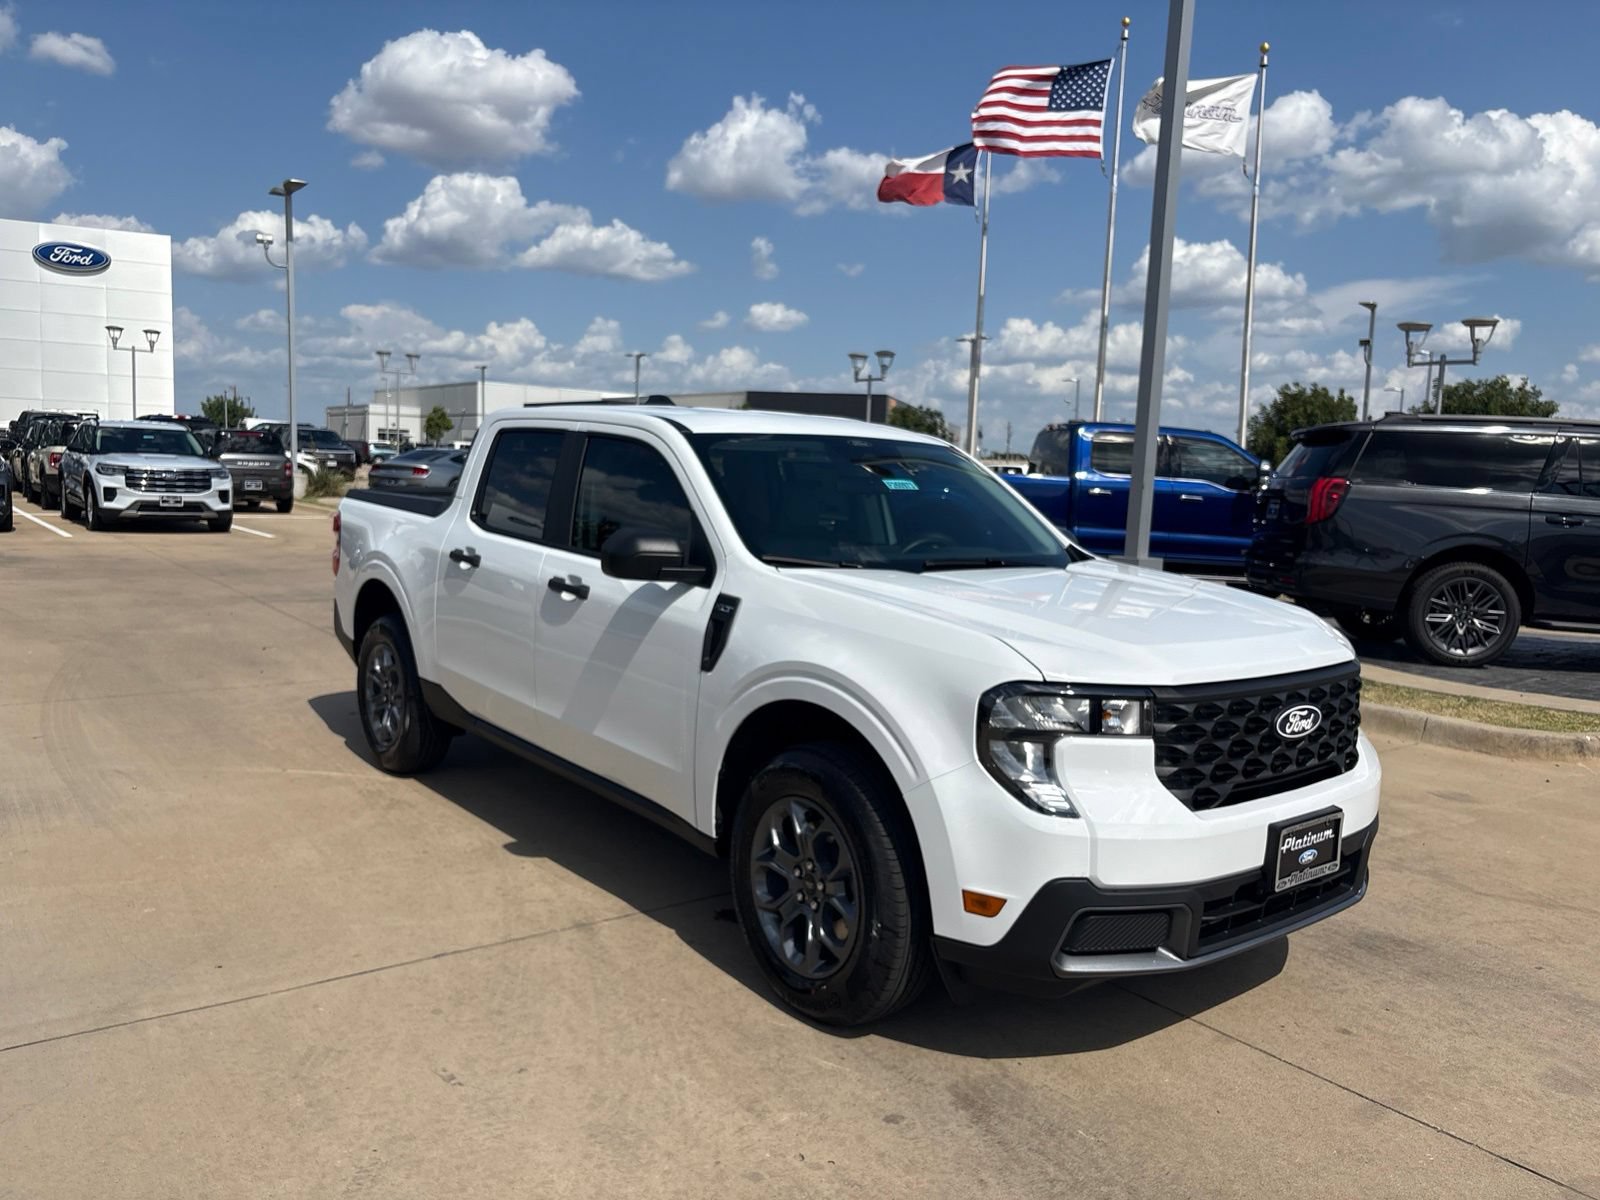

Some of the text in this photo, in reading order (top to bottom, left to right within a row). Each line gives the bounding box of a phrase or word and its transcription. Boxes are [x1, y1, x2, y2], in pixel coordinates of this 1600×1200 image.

[49, 246, 93, 265] Ford
[1285, 710, 1314, 733] Ford
[1280, 828, 1335, 854] Platinum
